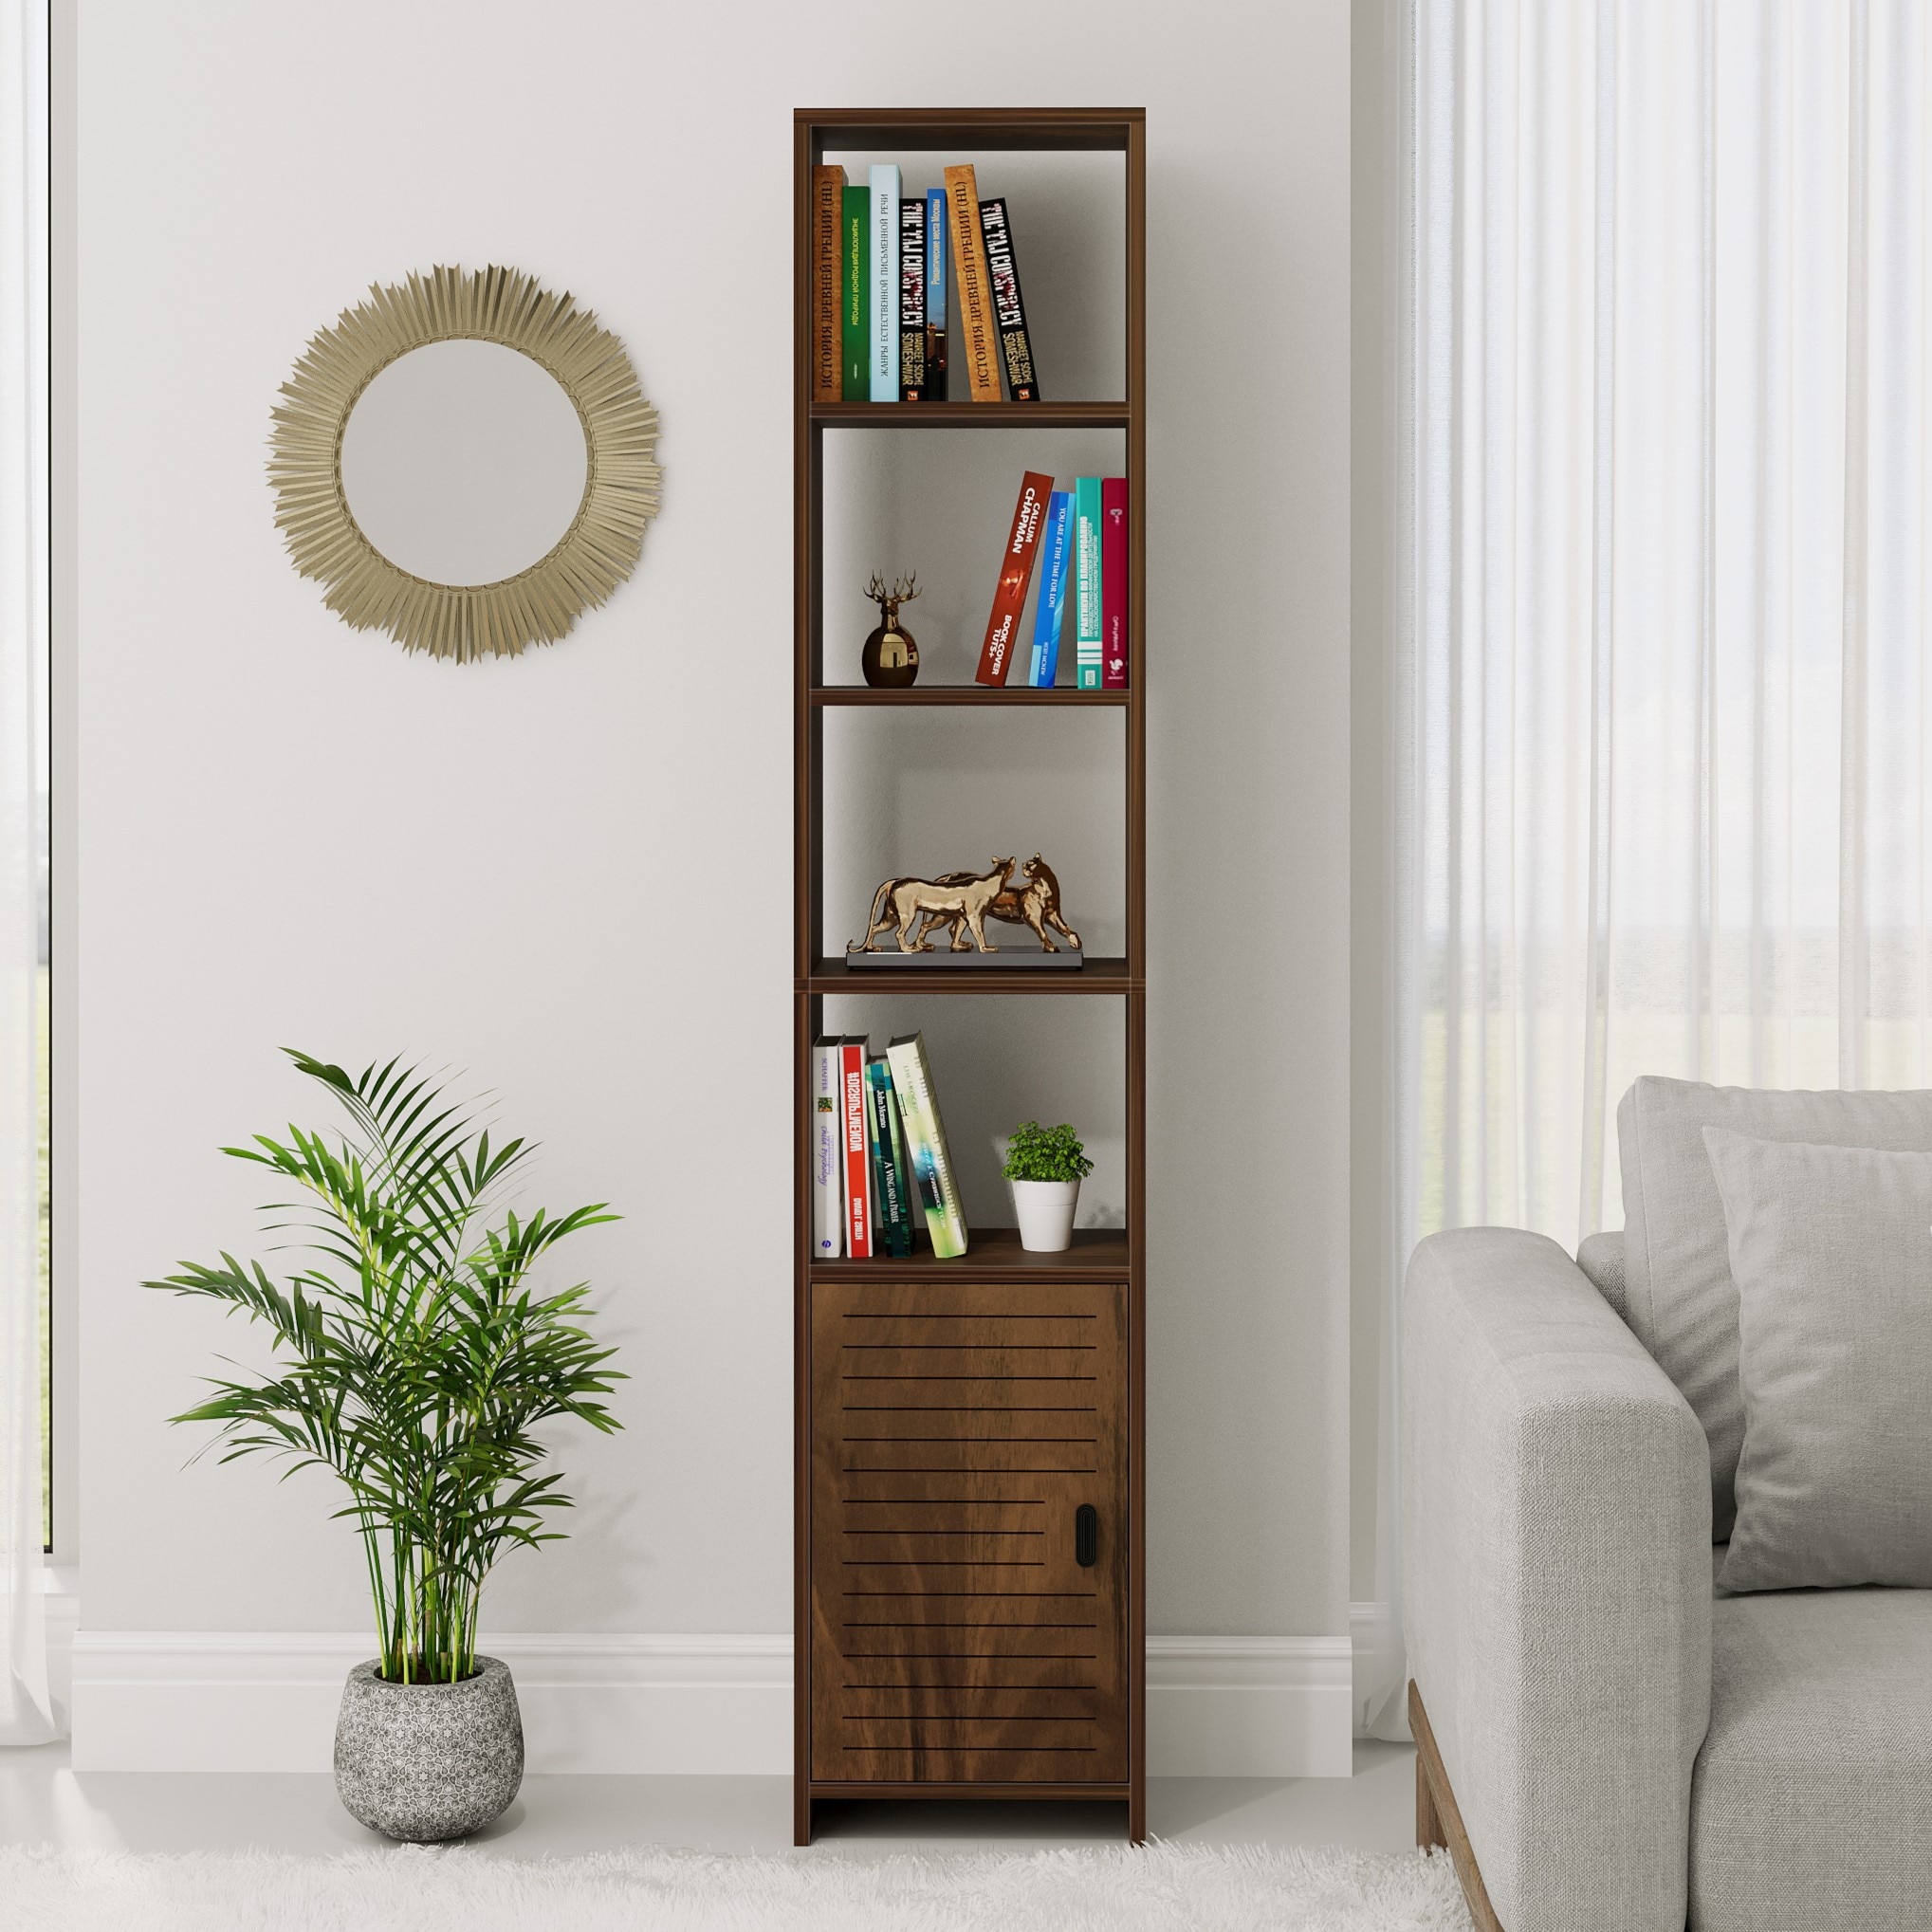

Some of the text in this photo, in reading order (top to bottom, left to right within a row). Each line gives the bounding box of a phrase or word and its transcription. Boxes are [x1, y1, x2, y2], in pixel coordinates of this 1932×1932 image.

[931, 199, 941, 285] Романтические места Москвы
[902, 203, 923, 326] THE TAJ CONSPIRACY
[982, 203, 1022, 326] THE TAJ CONSPIRACY
[819, 180, 834, 389] ИСТОРИЯ ДРЕВНЕЙ ГРЕЦИИ (HL)
[879, 193, 889, 377] ЖАНРЫ ЕСТЕСТВЕННОЙ ПИСЬМЕННОЙ РЕЧИ
[954, 181, 989, 389] ИСТОРИЯ ДРЕВНЕЙ ГРЕЦИИ (HL)
[902, 333, 913, 385] SOMESHWAR
[913, 363, 924, 386] SODHI
[1003, 332, 1023, 386] SOMESHWAR
[1021, 362, 1033, 384] SODHI
[1012, 487, 1036, 554] CHAPMAN
[1025, 503, 1040, 543] CALLUM
[1058, 507, 1067, 523] YOU
[1053, 545, 1061, 561] THE
[1055, 536, 1063, 545] AT
[1049, 580, 1058, 593] FOR
[1051, 561, 1060, 580] TIME
[1079, 516, 1089, 637] ПРАКТИКУМ ПО ПЛАНИРОВАНИЮ
[988, 628, 1002, 658] TUTS+
[991, 615, 1013, 675] BOOK COVER
[876, 1090, 886, 1105] John
[818, 1149, 828, 1186] Psychology
[885, 1168, 895, 1187] WING
[888, 1187, 896, 1199] AND
[890, 1203, 899, 1224] PRAYER
